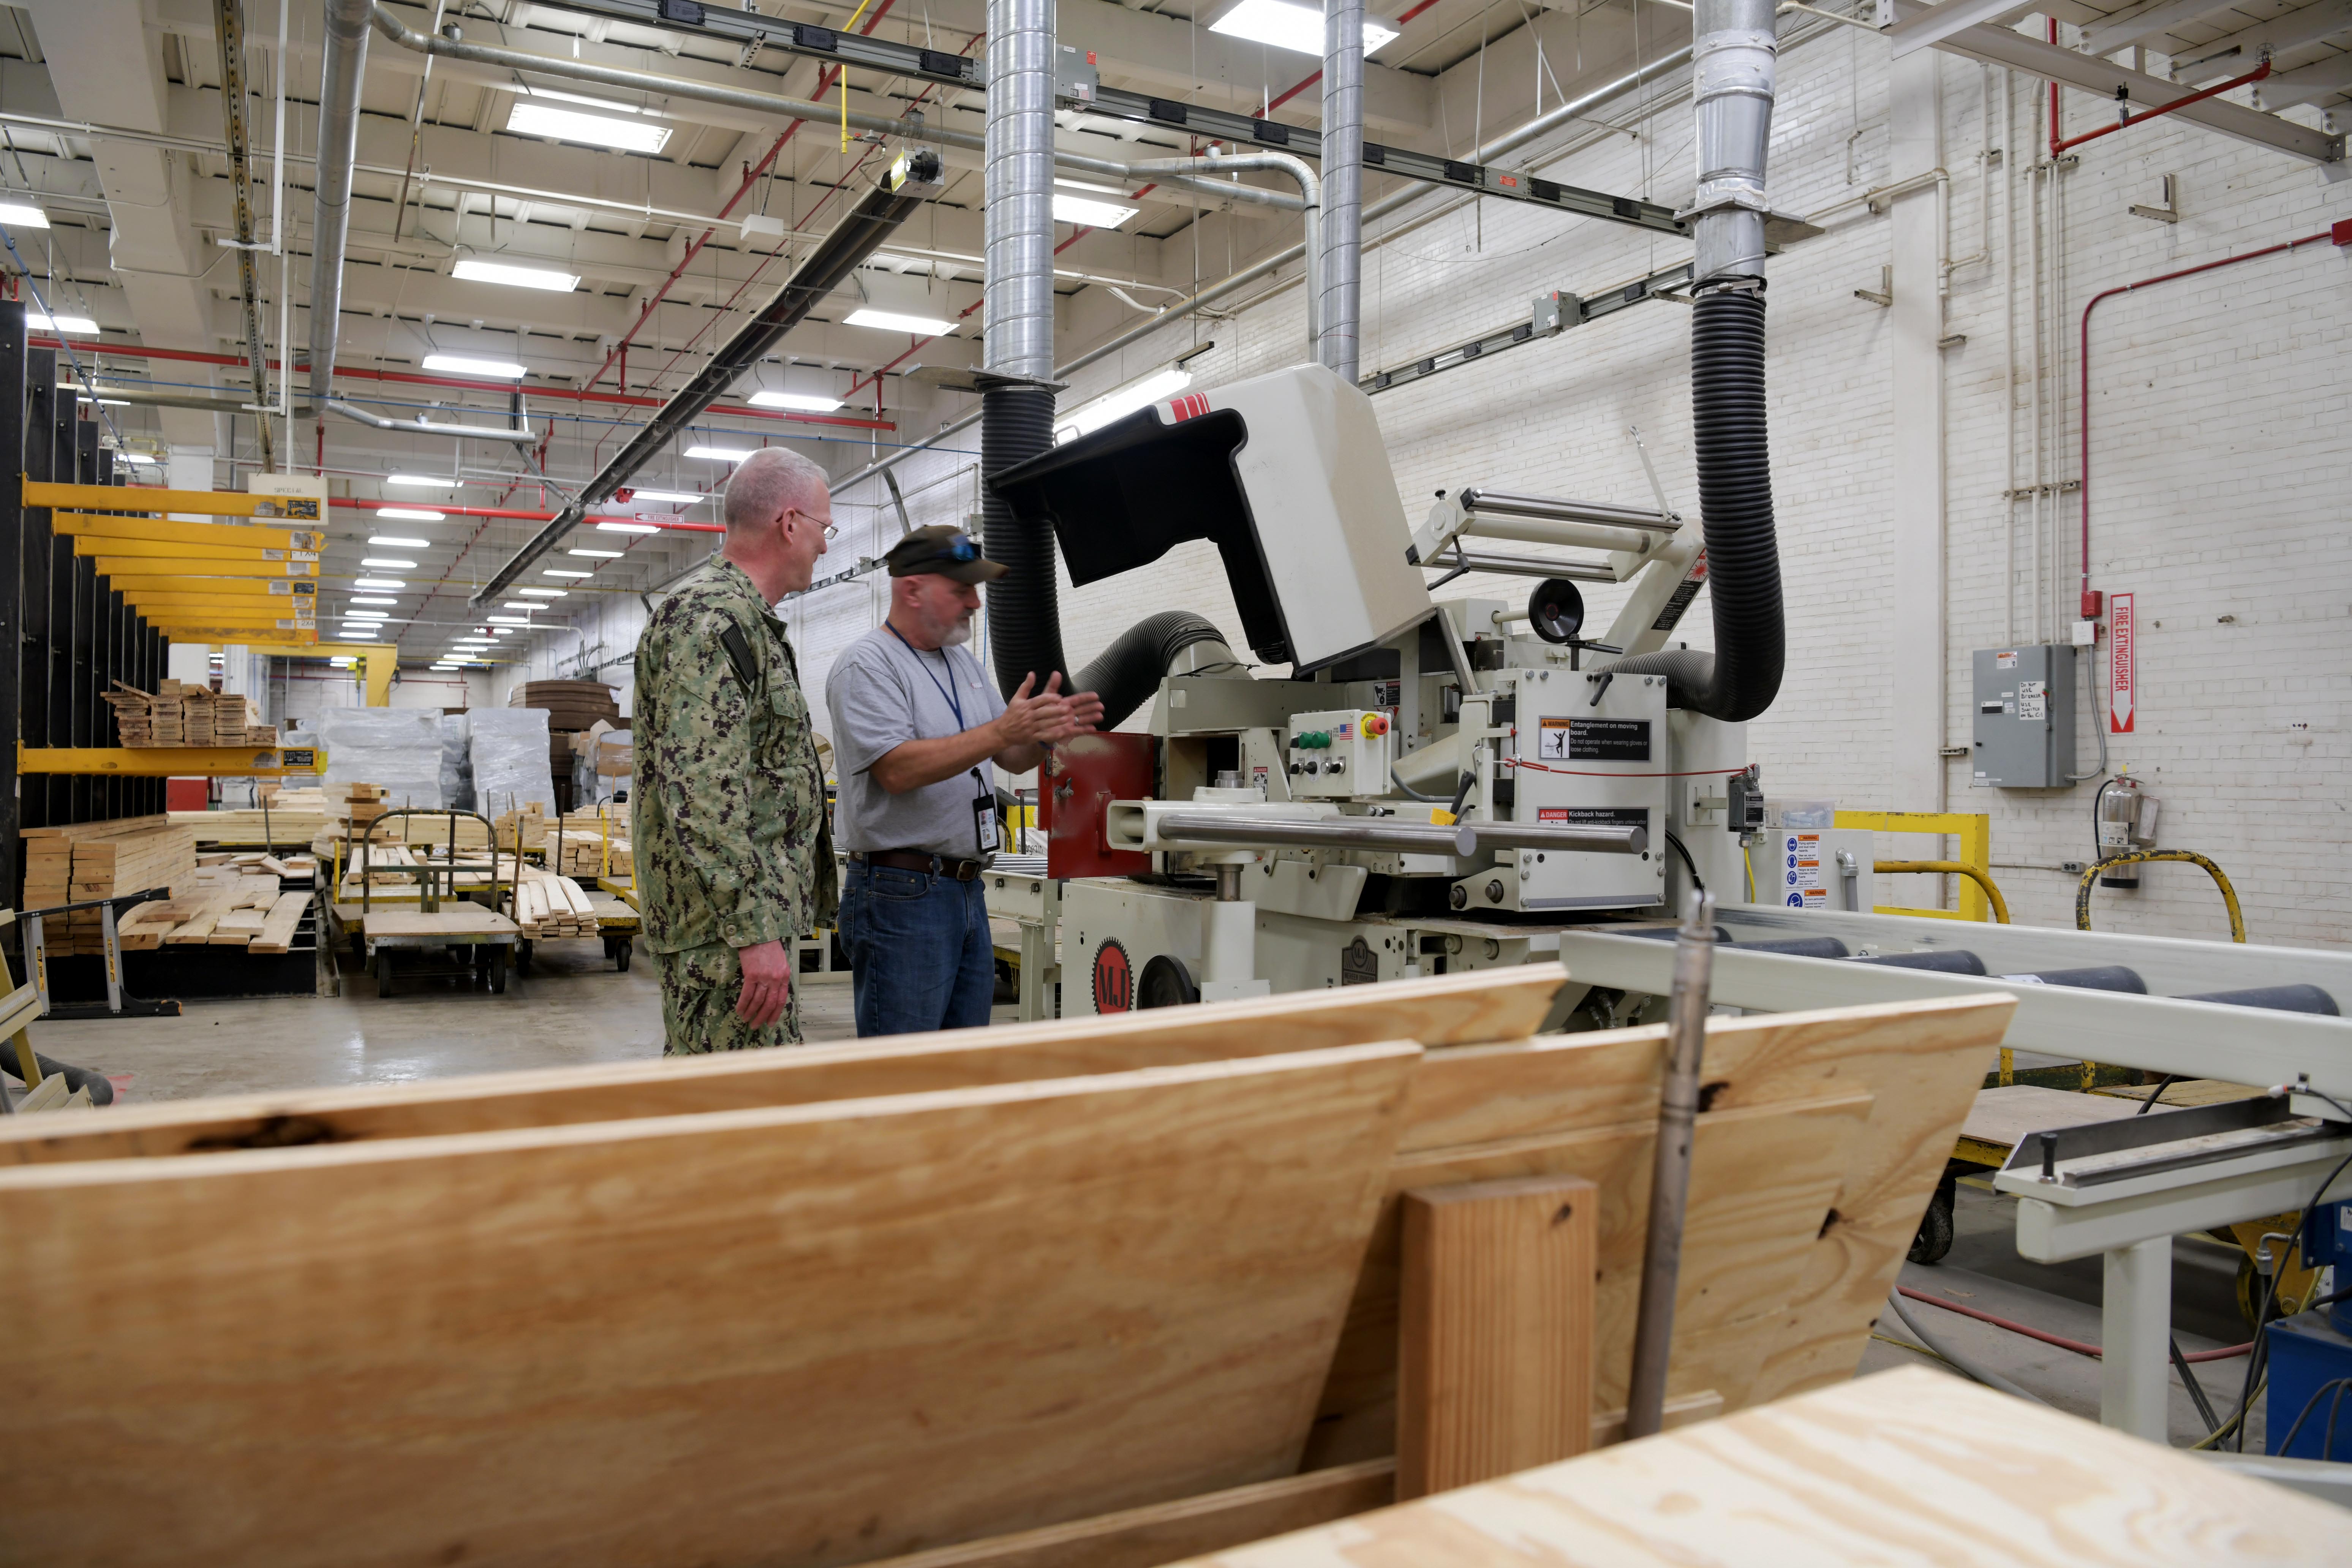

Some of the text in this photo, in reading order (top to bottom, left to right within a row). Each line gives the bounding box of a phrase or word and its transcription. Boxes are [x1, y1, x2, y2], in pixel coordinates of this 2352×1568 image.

[2115, 607, 2129, 691] FIRE EXTINGUISHER
[1361, 713, 1377, 722] EMERGEN
[1099, 963, 1127, 1008] MJ
